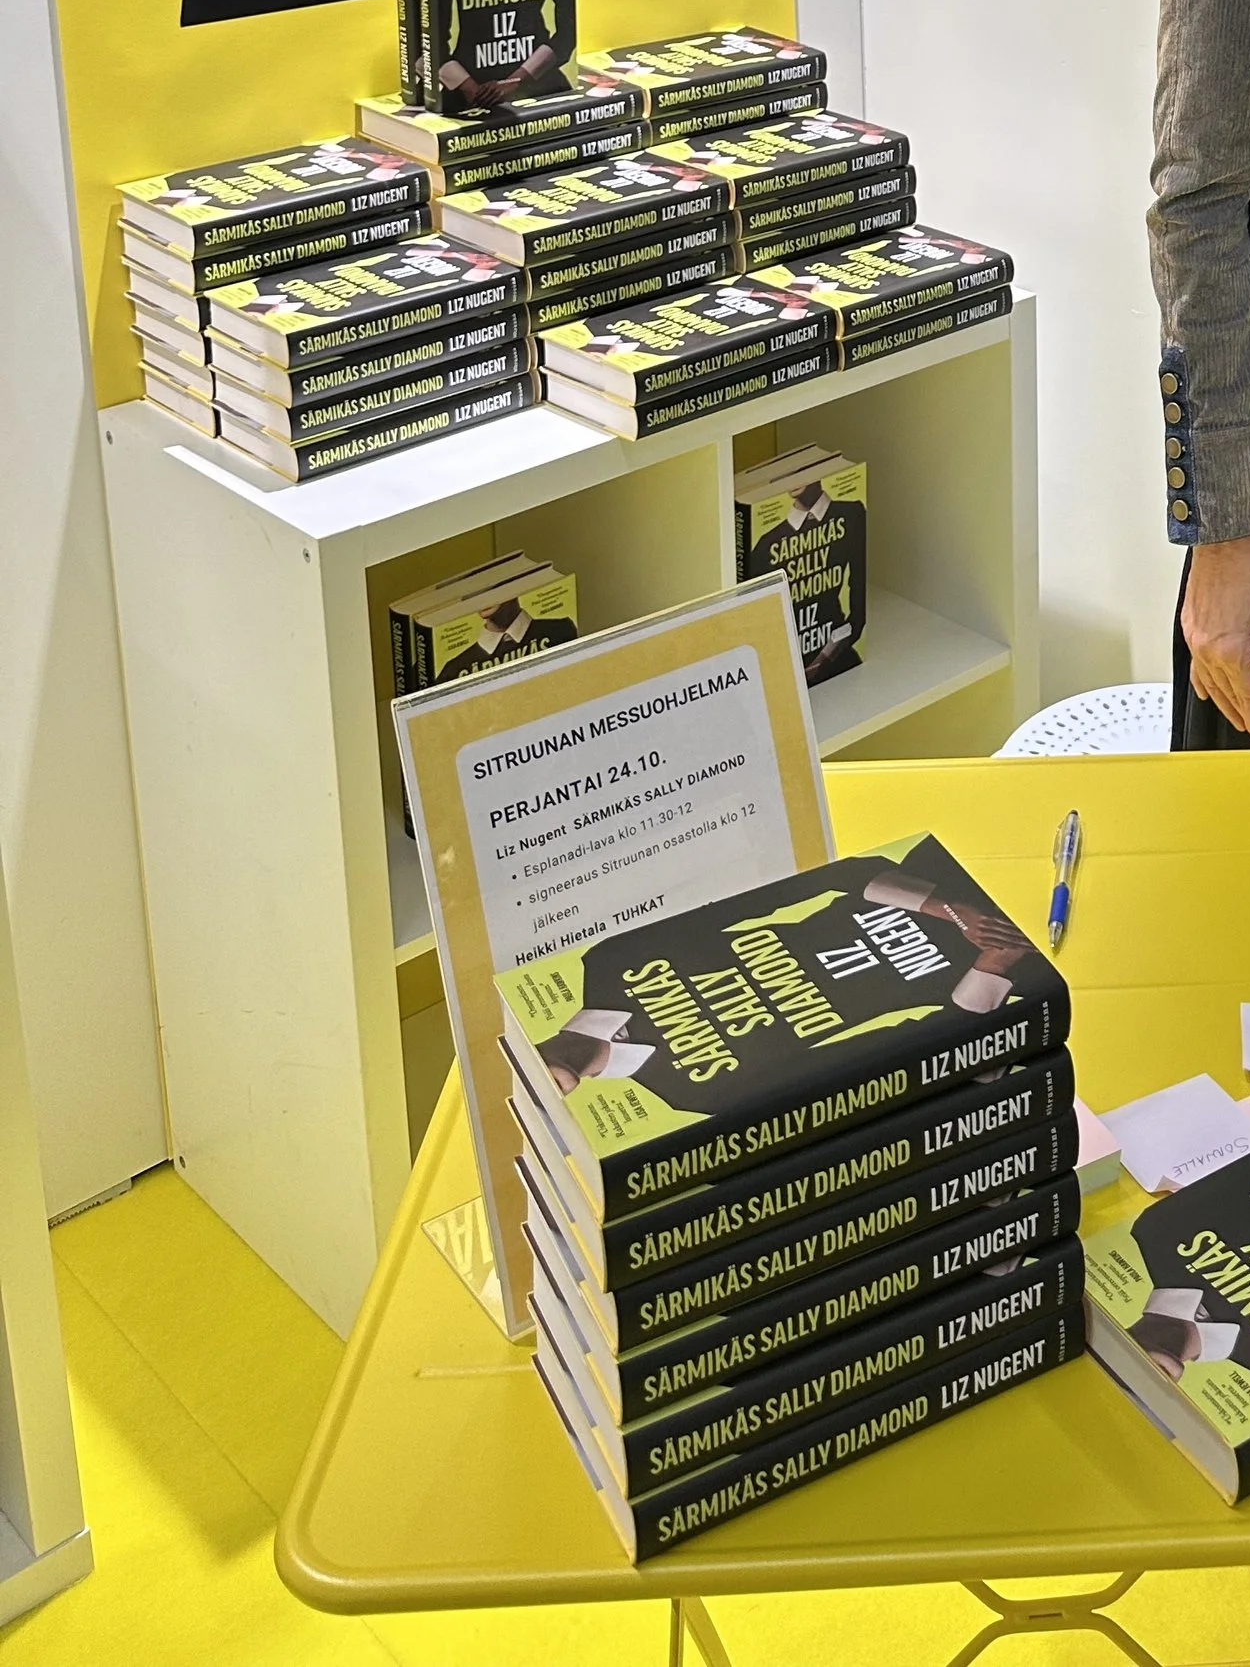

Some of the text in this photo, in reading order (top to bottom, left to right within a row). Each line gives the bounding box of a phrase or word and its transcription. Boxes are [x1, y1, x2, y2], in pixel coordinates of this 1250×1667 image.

[476, 36, 535, 69] NUGENT
[493, 11, 516, 38] LIZ
[205, 186, 409, 246] SÄRMIKÄS SALLY DIAMOND LIZ NUGENT
[851, 267, 999, 326] SÄRMIKÄS SALLY DIAMOND LIZ NUGENT
[647, 357, 820, 427] SÄRMIKÄS SALLY DIAMOND LIZ NUGENT
[308, 392, 512, 469] SÄRMIKÄS SALLY DIAMOND LIZ NUGENT
[770, 517, 845, 565] SÄRMIKÄS
[787, 546, 830, 582] SALLY
[791, 565, 842, 603] AMOND
[800, 603, 819, 632] LIZ
[799, 622, 833, 655] GENT
[474, 667, 749, 780] SITRUUNAN MESSUOHJELMAA
[490, 751, 666, 828] PERJANTAI 24.10.
[497, 754, 745, 860] Liz Nugent SÄRMIKÄS SALLY DIAMOND
[524, 802, 693, 878] Esplanadi-lava klo 11.30-12
[529, 803, 756, 904] signeeraus Sitruunan osastolla klo 12
[516, 894, 666, 966] Heikki Hietala TUHKAT
[533, 904, 579, 933] jälkeen
[852, 907, 951, 981] NUGENT
[730, 930, 844, 1038] DIAMOND
[816, 939, 881, 980] LIZ
[623, 959, 739, 1082] SÄRMIKÄS
[689, 966, 774, 1037] SALLY
[627, 1021, 1029, 1200] SÄRMIKÄS SALLY DIAMOND LIZ NUGENT
[629, 1090, 1032, 1269] SÄRMIKÄS SALLY DIAMOND LIZ NUGENT
[640, 1147, 1037, 1330] SÄRMIKÄS SALLY DIAMOND LIZ NUGENT
[644, 1213, 1040, 1403] SÄRMIKÄS SALLY DIAMOND LIZ NUGENT
[650, 1283, 1044, 1475] SÄRMIKÄS SALLY DIAMOND LIZ NUGENT
[658, 1340, 1045, 1542] SÄRMIKÄS SALLY DIAMOND LIZ NUGENT
